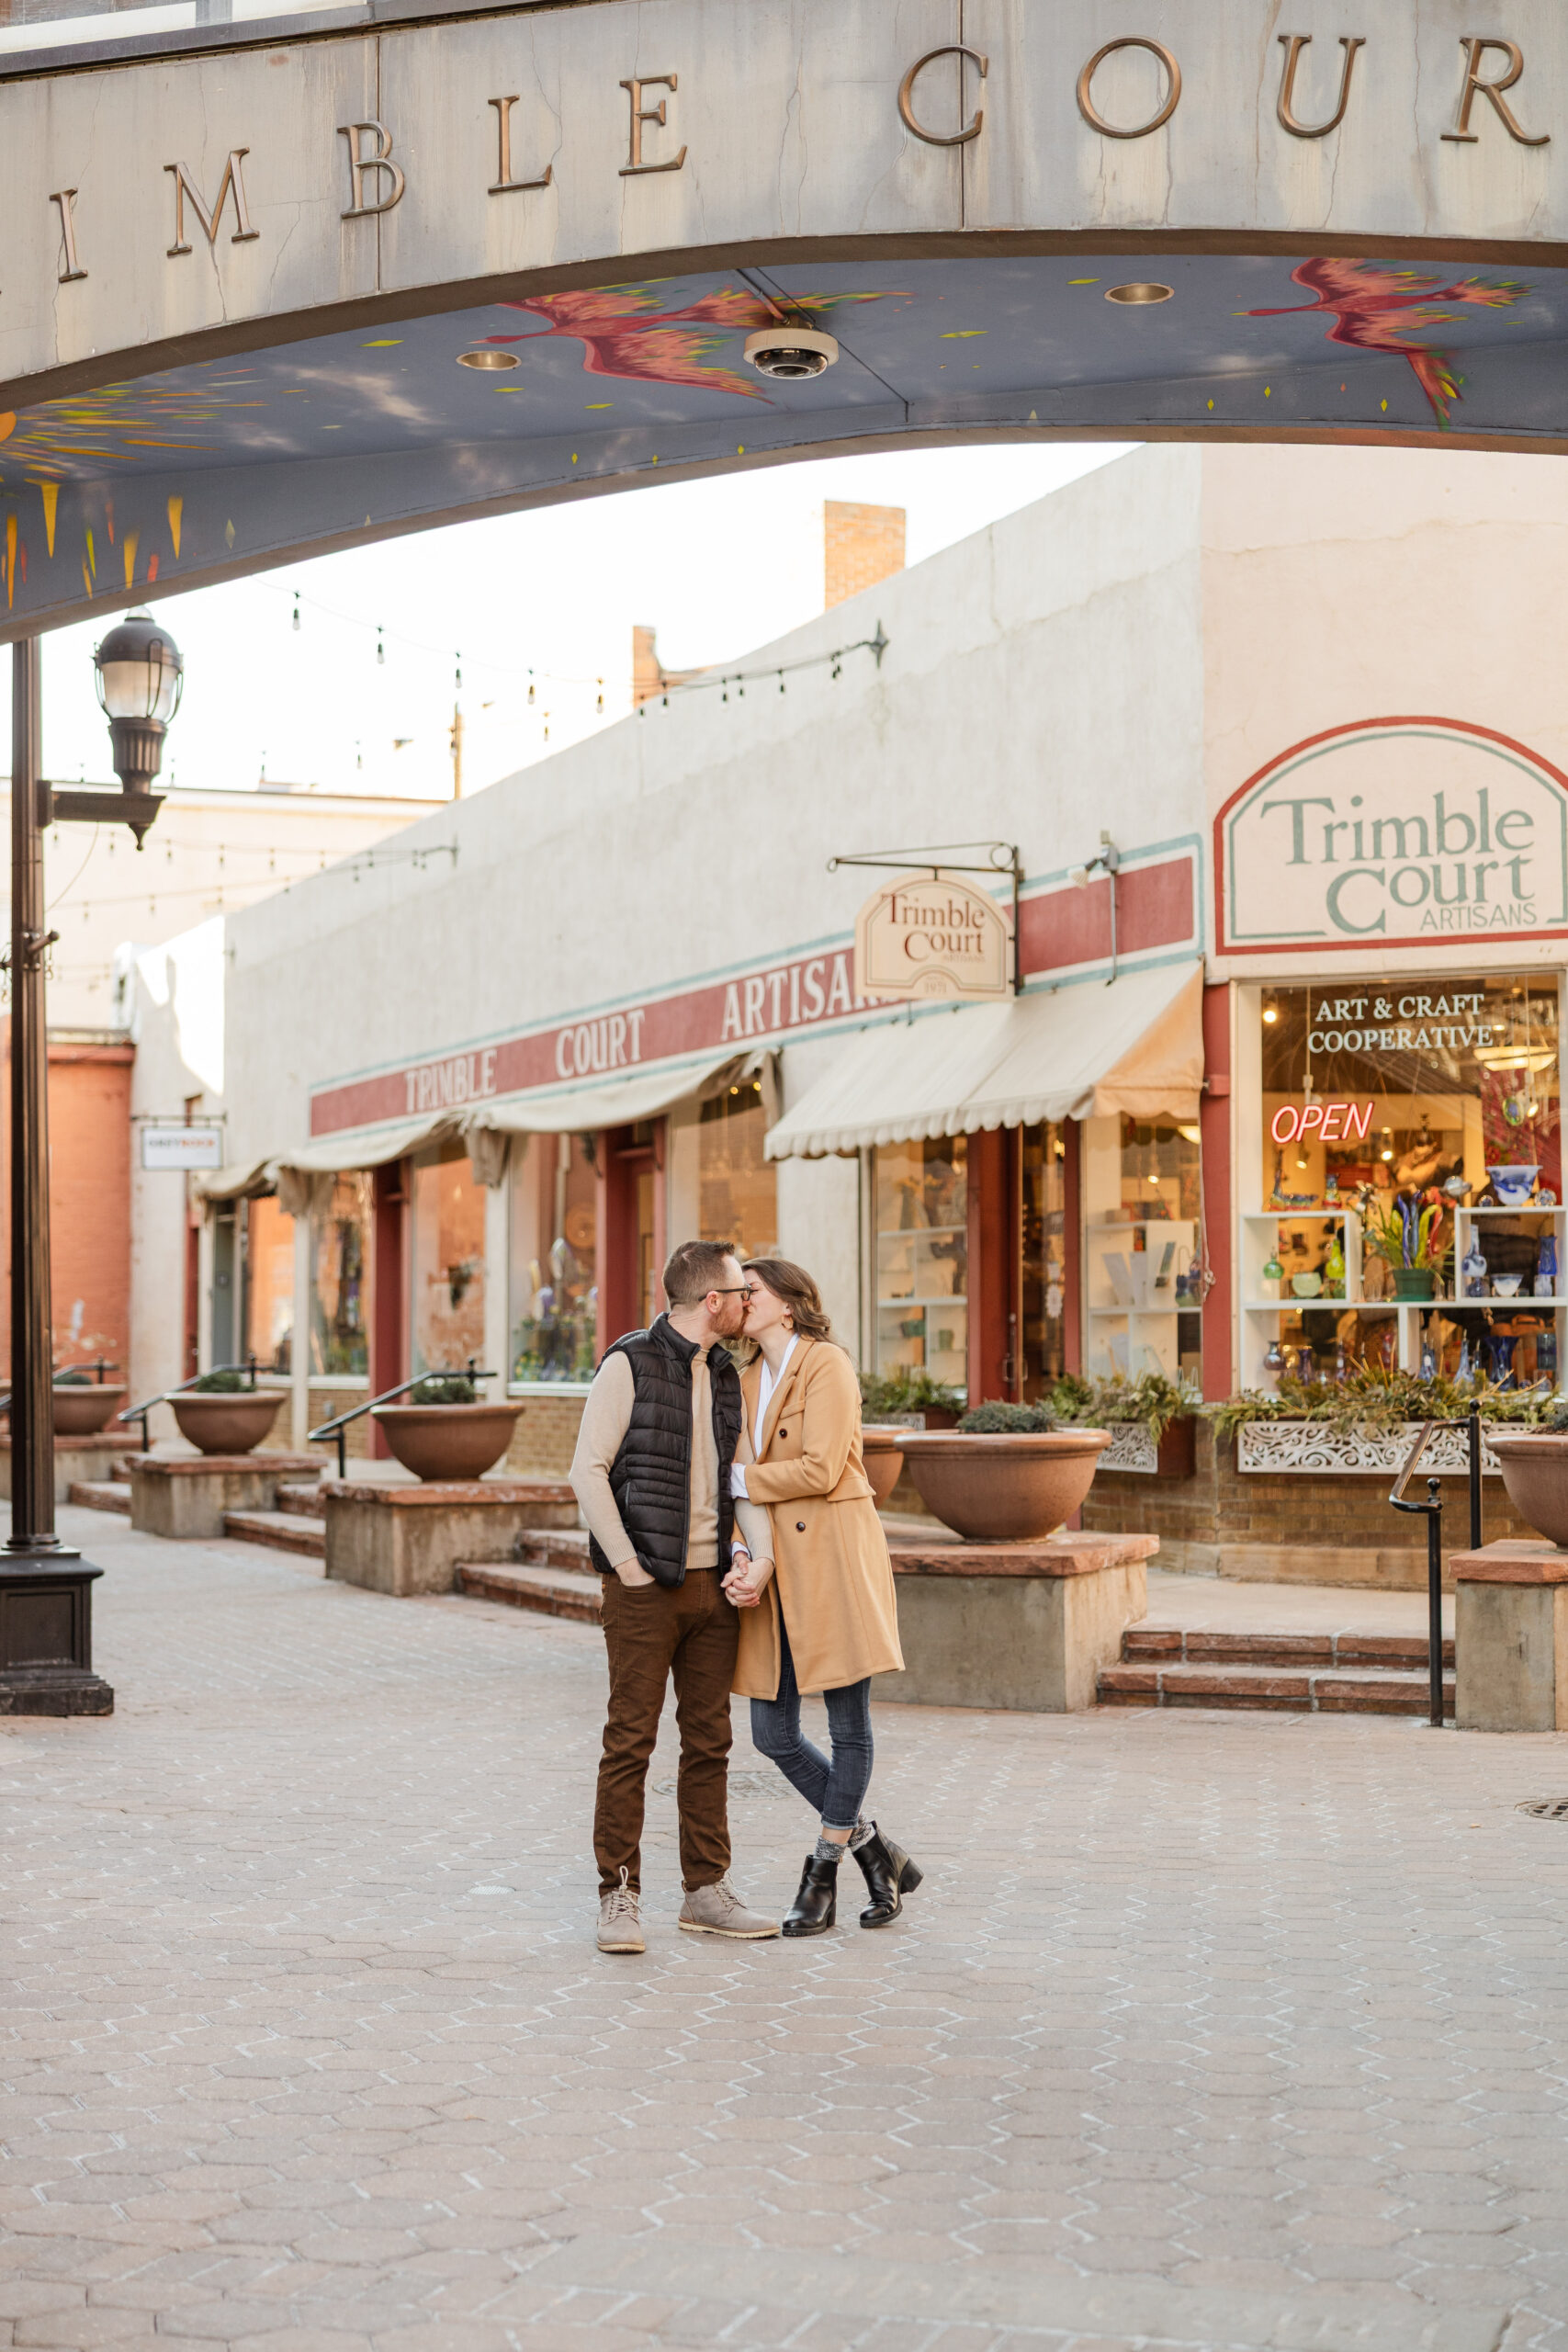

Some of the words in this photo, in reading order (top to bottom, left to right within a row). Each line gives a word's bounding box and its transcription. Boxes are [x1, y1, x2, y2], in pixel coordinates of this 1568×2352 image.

[897, 33, 1551, 147] COUR
[1260, 786, 1535, 866] Trimble
[880, 892, 986, 930] Trimble
[1325, 854, 1536, 934] Court
[1420, 902, 1538, 932] ARTISANS
[904, 930, 984, 962] Court
[1315, 998, 1369, 1023] ART
[1372, 997, 1393, 1020] &
[1398, 993, 1484, 1019] CRAFT
[404, 1048, 498, 1114] TRIMBLE
[555, 1009, 646, 1079] COURT
[720, 953, 900, 1042] ARTISA
[1307, 1024, 1495, 1054] COOPERATIVE
[1270, 1102, 1374, 1144] OPEN
